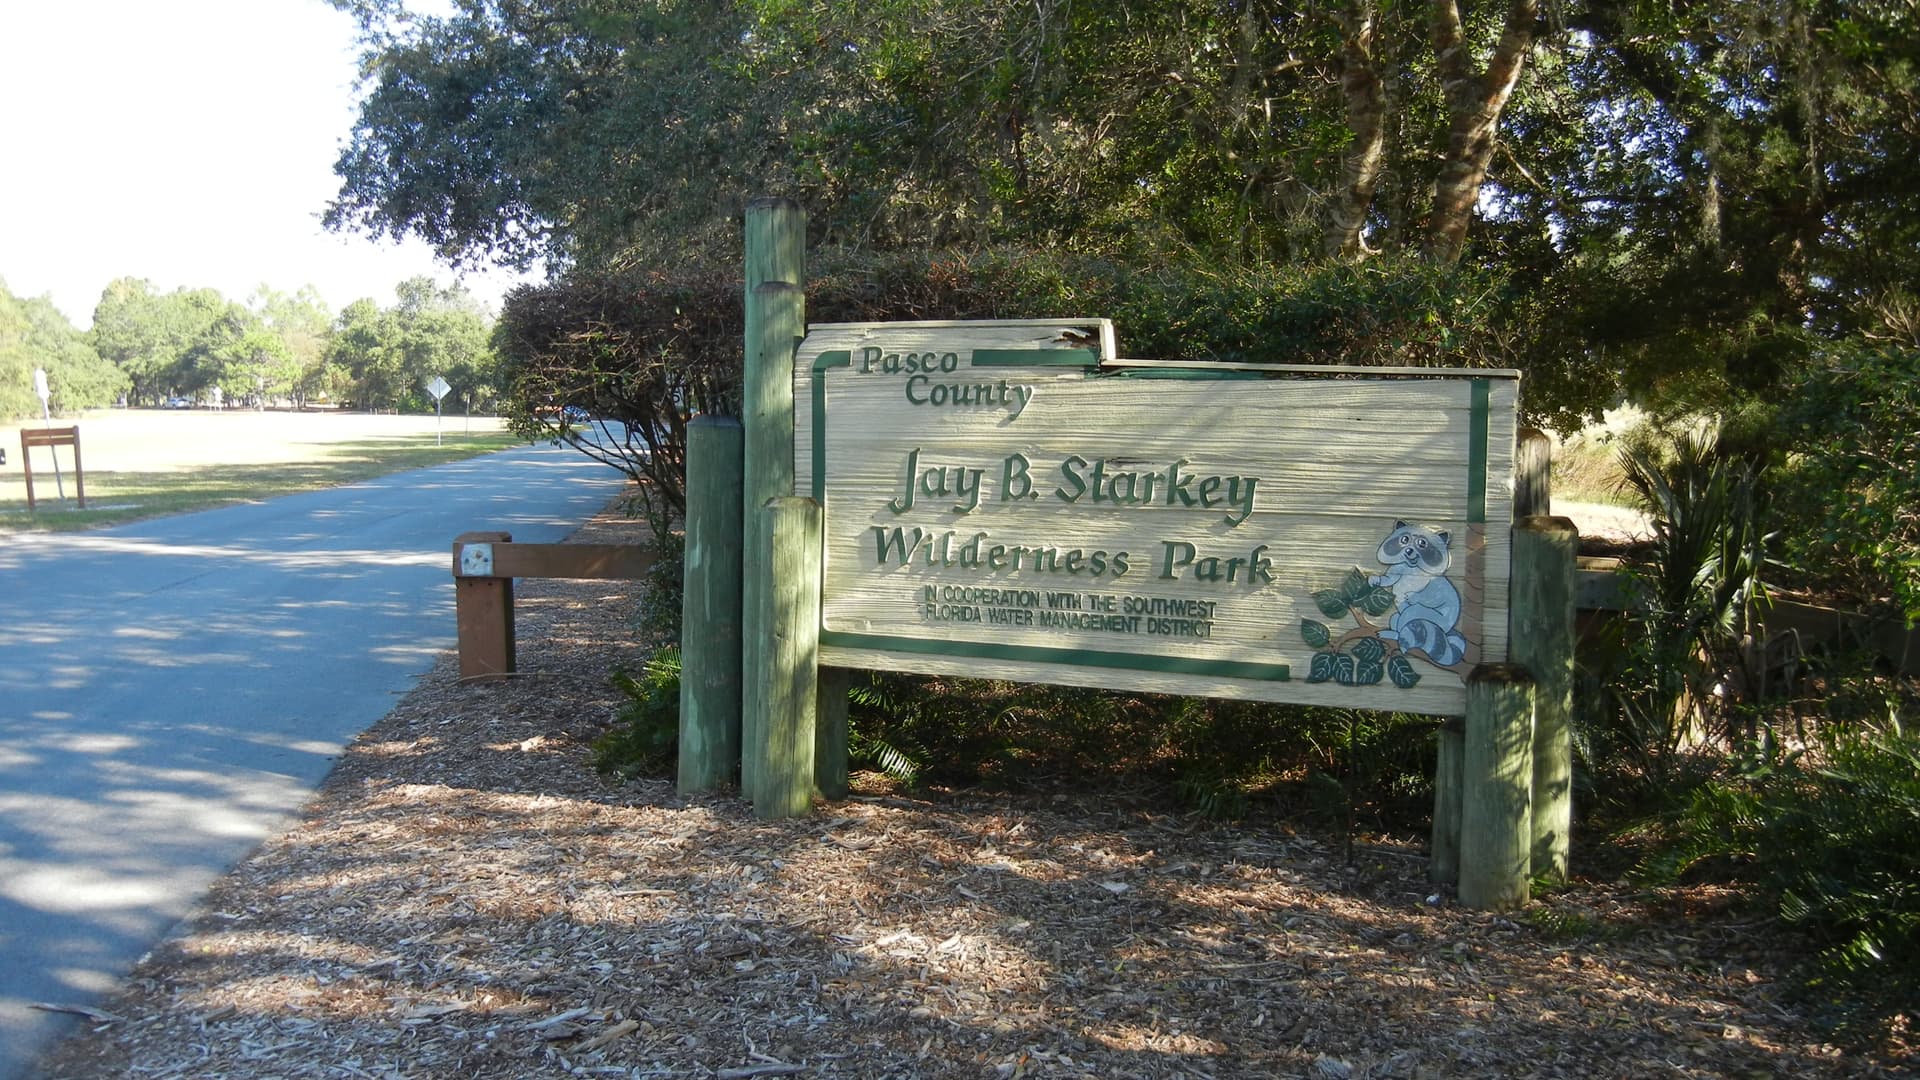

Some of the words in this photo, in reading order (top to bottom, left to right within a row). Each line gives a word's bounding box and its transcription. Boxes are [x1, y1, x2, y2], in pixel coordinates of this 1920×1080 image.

[860, 346, 958, 374] Pasco
[905, 375, 1034, 420] County
[888, 448, 984, 514] Jay
[1001, 452, 1039, 501] B.
[1056, 456, 1261, 527] Starkey
[871, 526, 1129, 578] Wilderness
[1159, 540, 1277, 584] Park
[925, 584, 938, 603] IN
[943, 585, 1040, 608] COOPERATION
[1047, 592, 1082, 610] WITH
[1088, 594, 1117, 612] THE
[1123, 596, 1217, 618] SOUTHWEST
[926, 603, 982, 622] FLORIDA
[988, 607, 1034, 626] WATER
[1040, 610, 1141, 633] MANAGEMENT
[1147, 617, 1214, 638] DISTRICT
